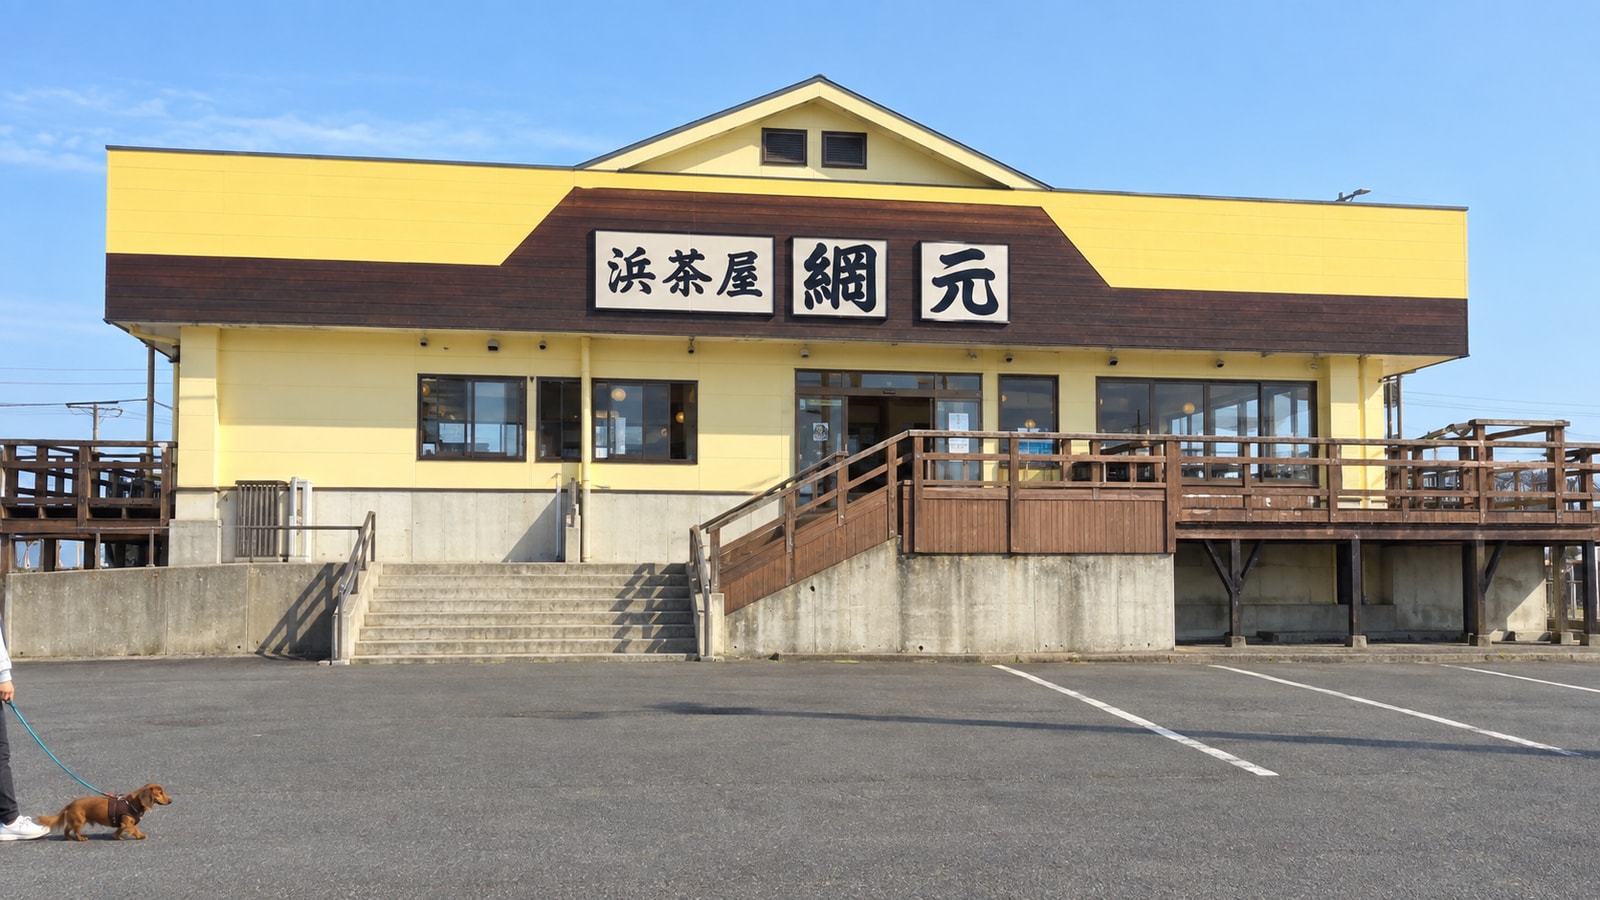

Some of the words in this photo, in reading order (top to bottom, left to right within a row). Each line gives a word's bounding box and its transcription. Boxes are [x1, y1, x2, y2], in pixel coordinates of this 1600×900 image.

[607, 246, 763, 298] 浜茶屋
[929, 247, 999, 316] 元
